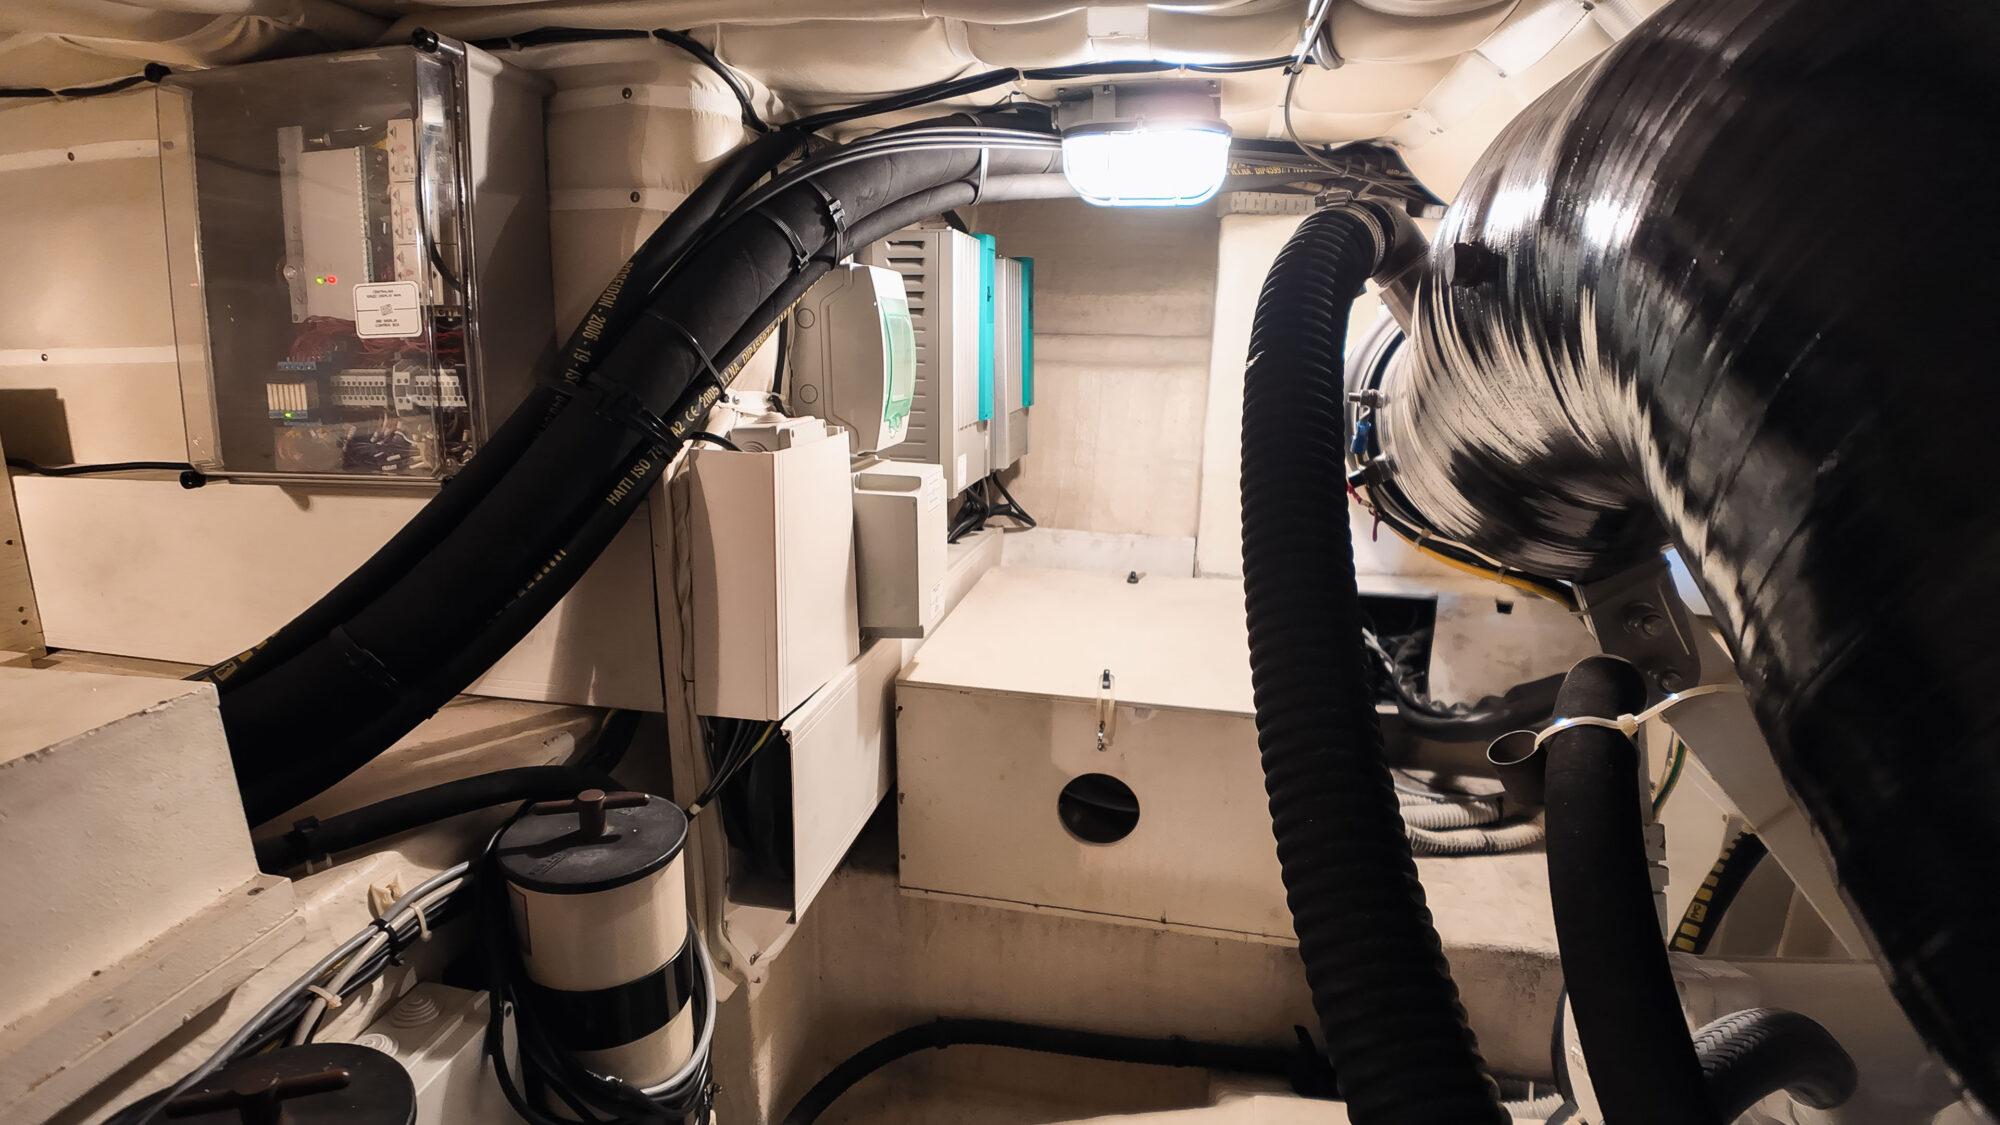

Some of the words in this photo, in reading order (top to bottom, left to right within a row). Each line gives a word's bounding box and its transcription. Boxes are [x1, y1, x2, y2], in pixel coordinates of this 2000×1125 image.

[598, 261, 634, 309] POSEIDON
[582, 313, 606, 342] 2006
[573, 348, 592, 363] 19
[605, 477, 635, 506] HAITI
[631, 459, 651, 479] ISO
[670, 421, 686, 437] A2
[699, 385, 720, 408] 2005
